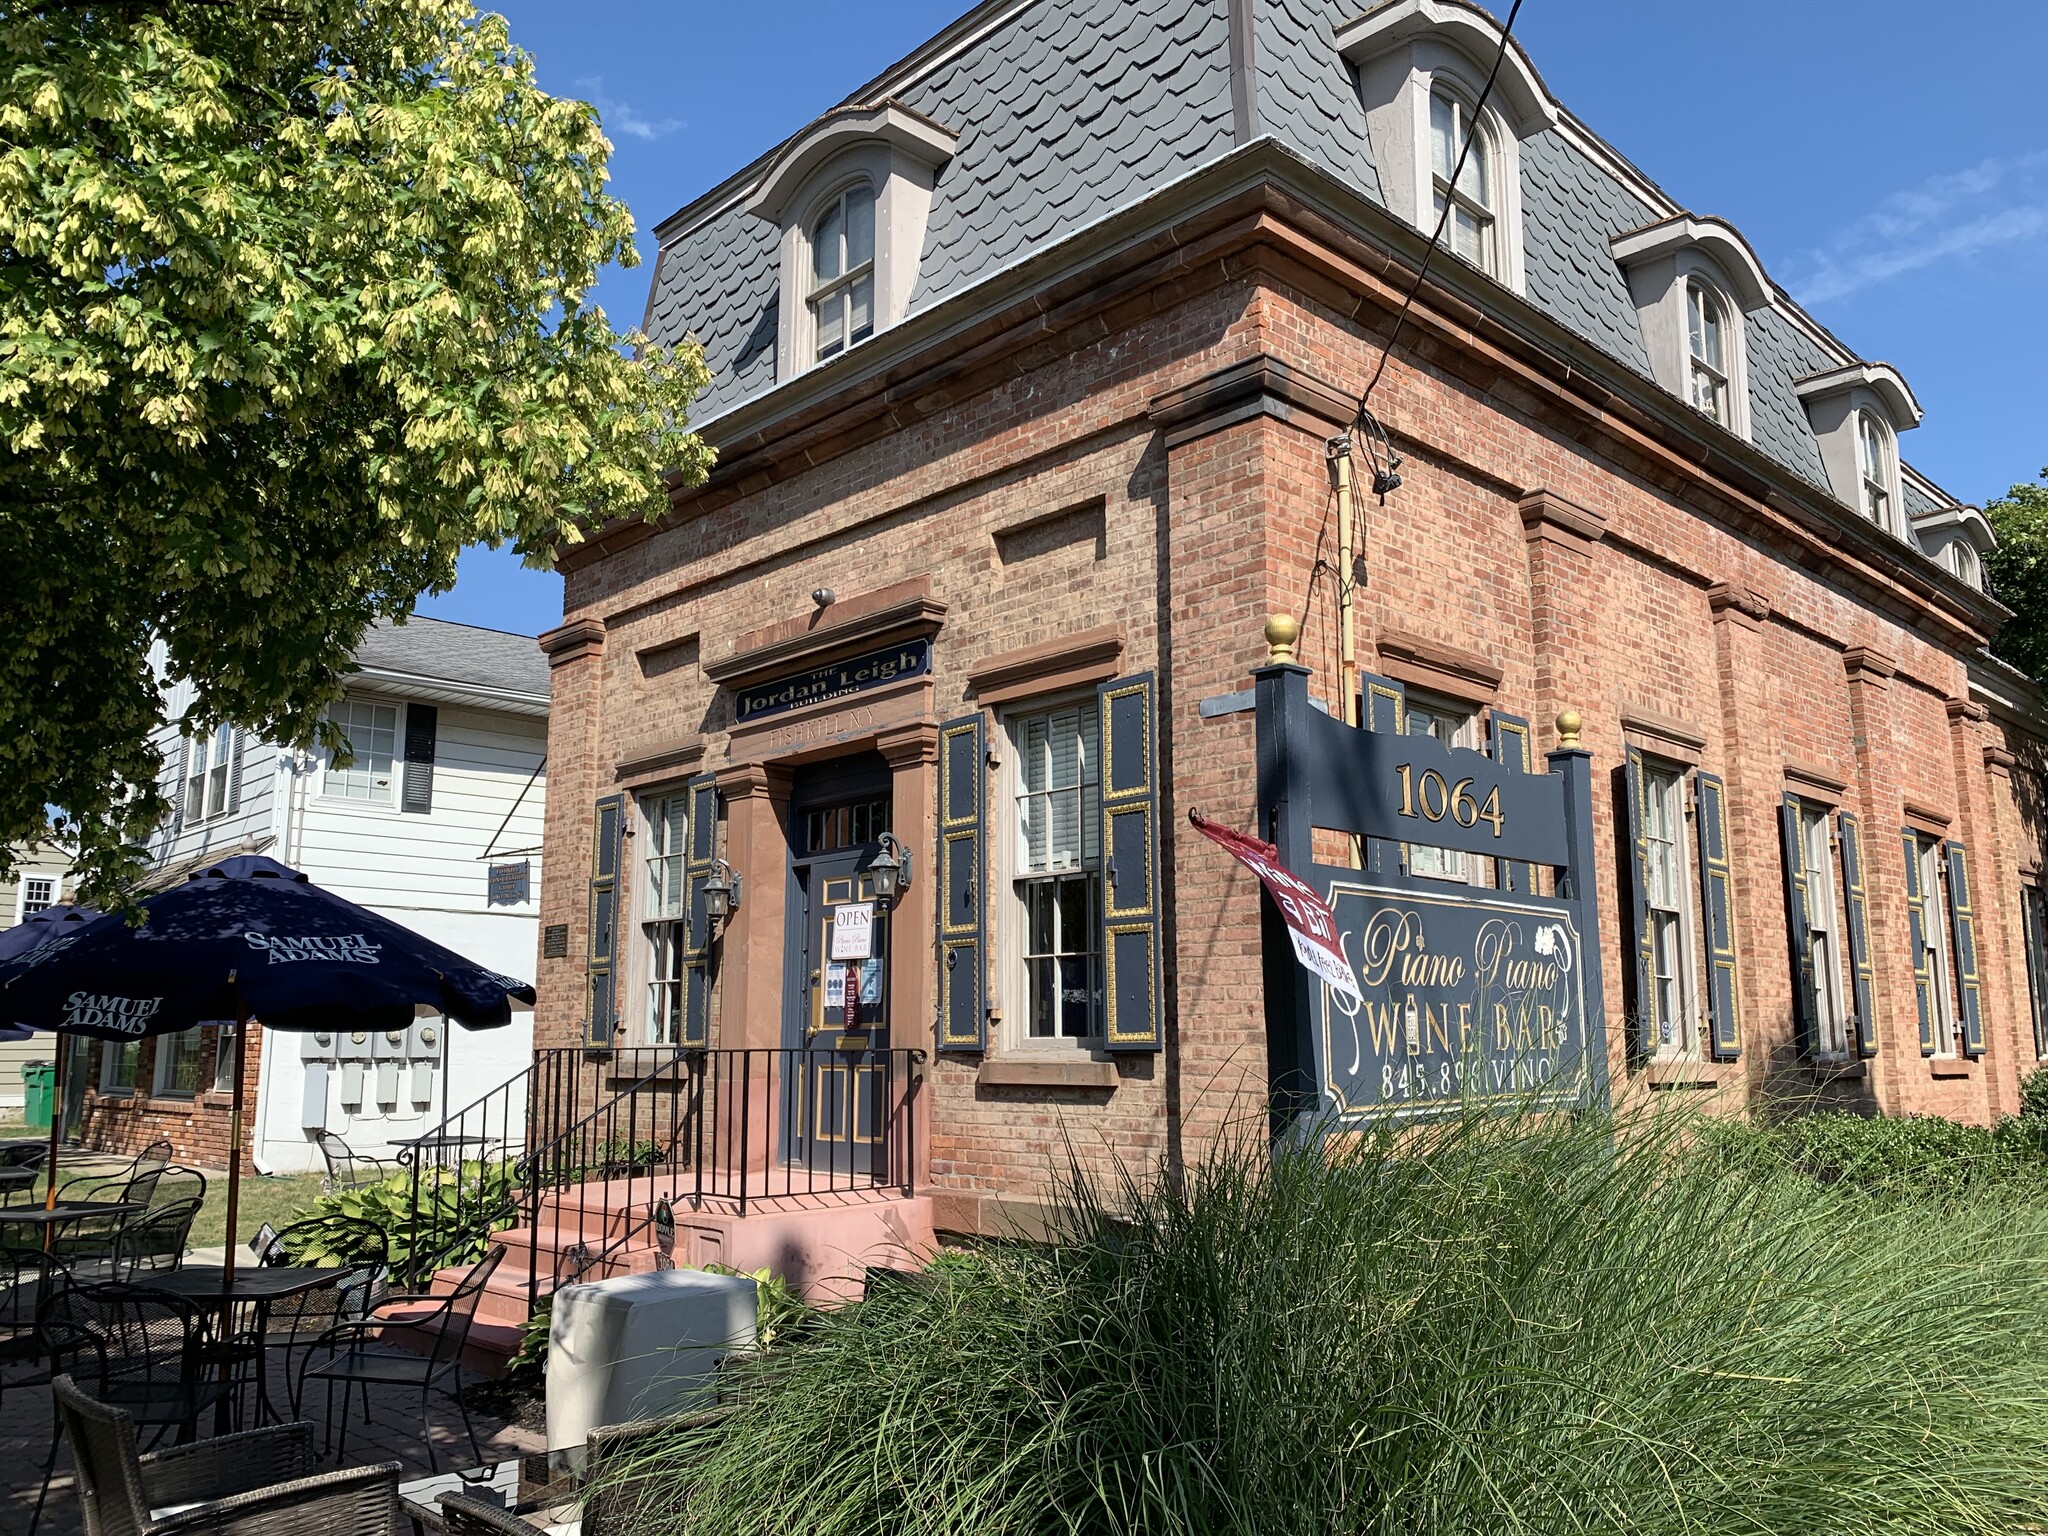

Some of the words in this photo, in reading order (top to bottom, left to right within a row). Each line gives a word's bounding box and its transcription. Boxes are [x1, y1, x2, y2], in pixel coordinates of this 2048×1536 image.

[744, 680, 827, 717] Jordan
[840, 651, 918, 687] Leigh
[811, 667, 838, 680] THE
[790, 685, 860, 709] BUILDING
[1396, 763, 1505, 839] 1064
[836, 909, 870, 927] OPEN
[244, 931, 382, 950] SAMUEL
[1362, 907, 1466, 988] Piano
[1474, 918, 1559, 991] Piano
[268, 949, 380, 964] ADAMS
[62, 991, 164, 1017] SAMUEL
[58, 1008, 151, 1035] ADAMS
[1363, 992, 1475, 1057] WINE
[1493, 1003, 1558, 1051] BAR
[656, 1222, 675, 1237] DOYLE
